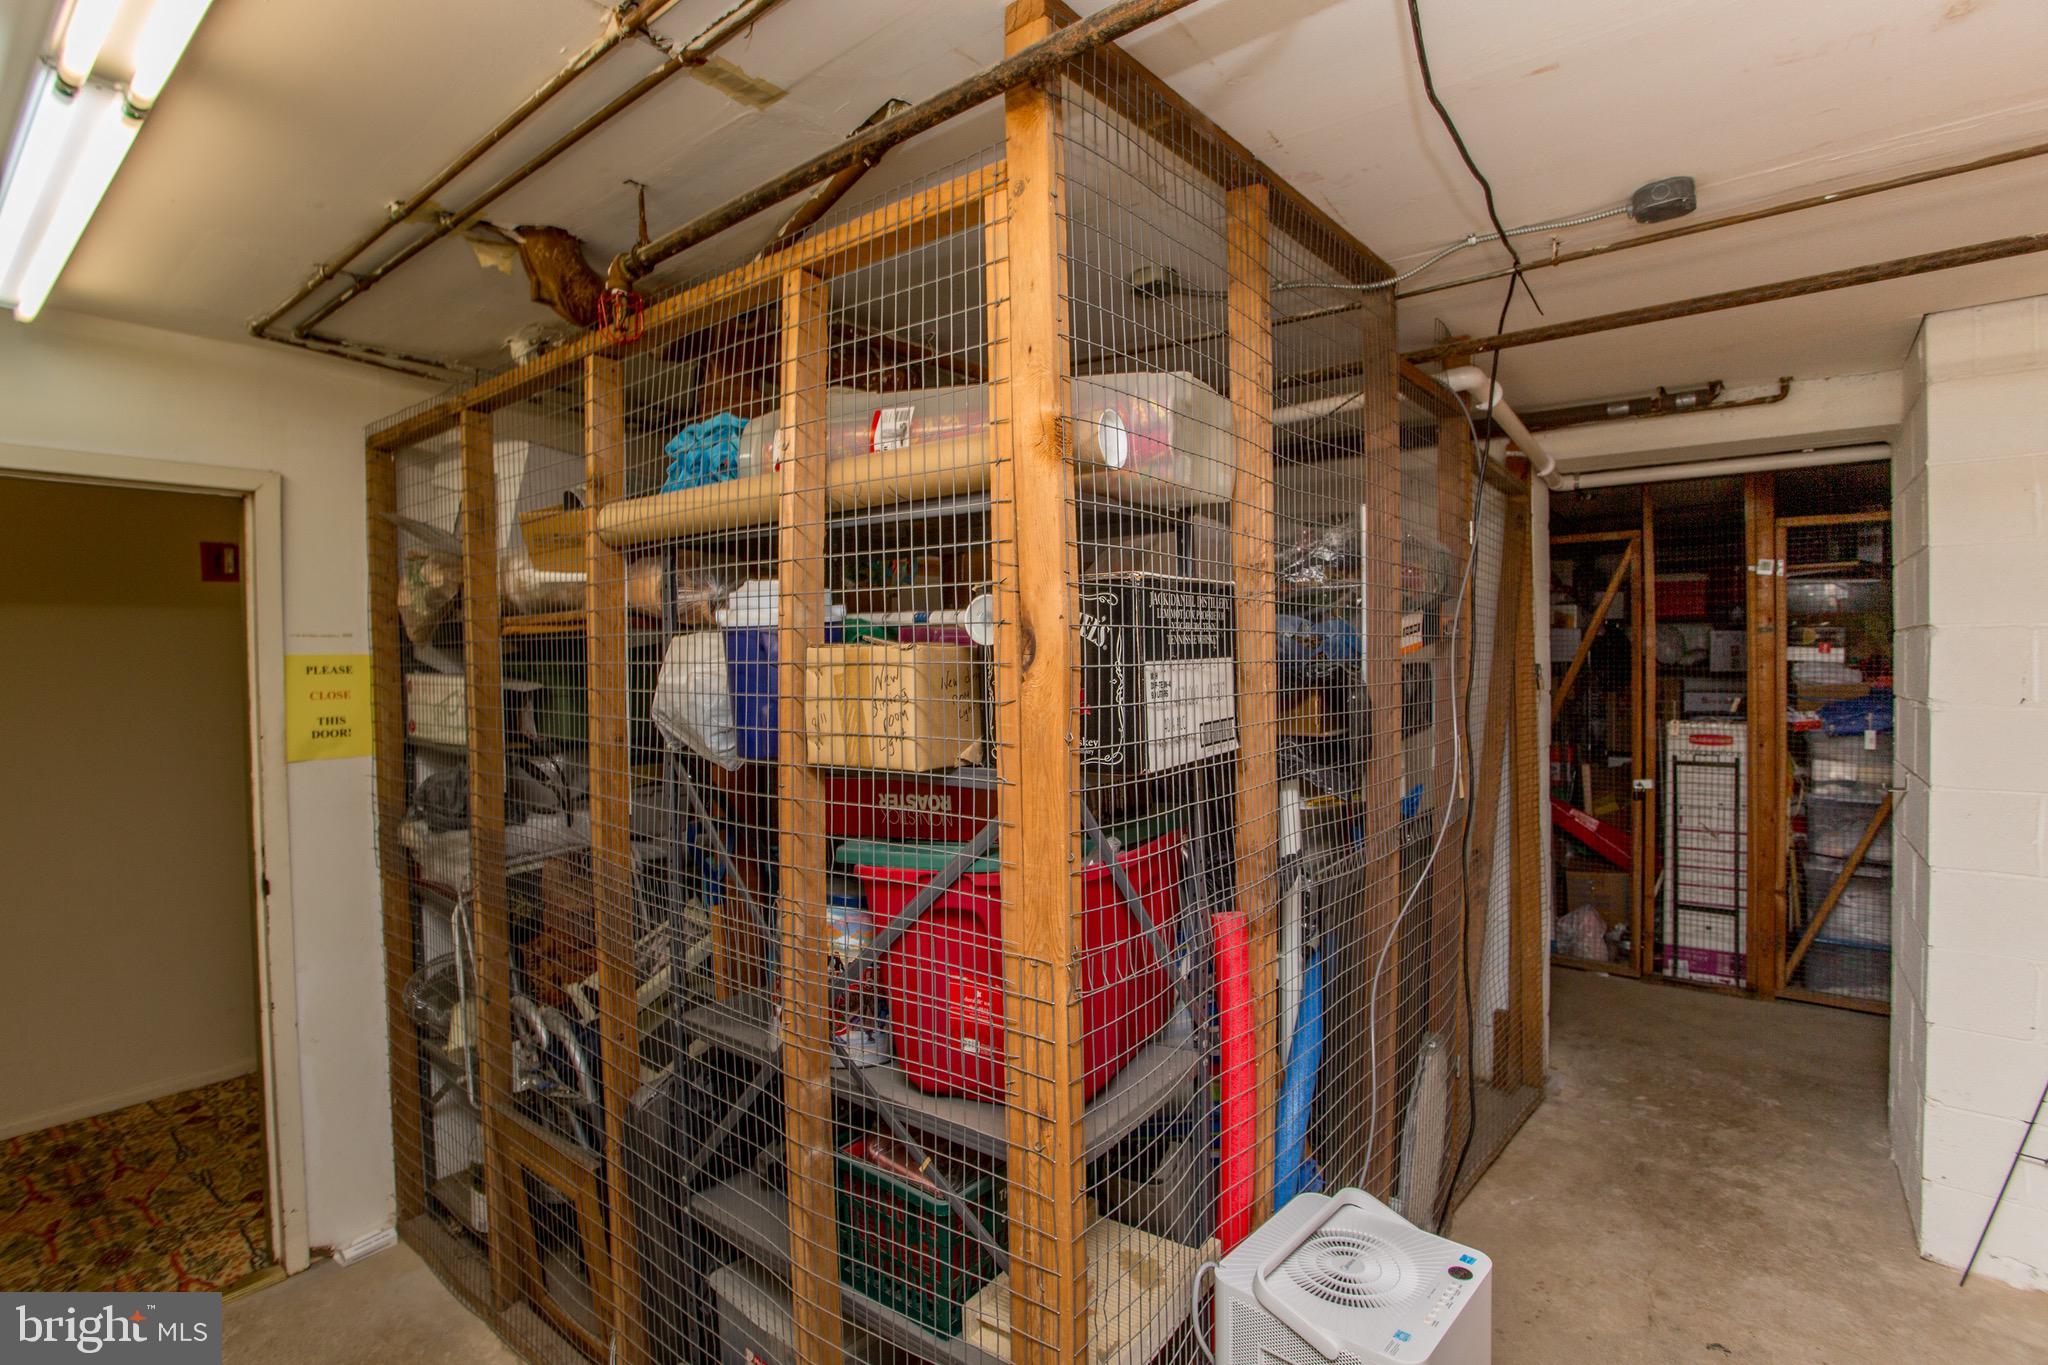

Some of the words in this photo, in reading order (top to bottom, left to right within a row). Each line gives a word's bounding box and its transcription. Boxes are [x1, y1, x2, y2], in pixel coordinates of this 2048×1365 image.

[306, 665, 353, 675] PLEASE
[309, 691, 351, 701] CLOSE
[318, 716, 347, 726] THIS
[312, 728, 352, 740] DOOR!
[878, 793, 953, 811] ROASTER
